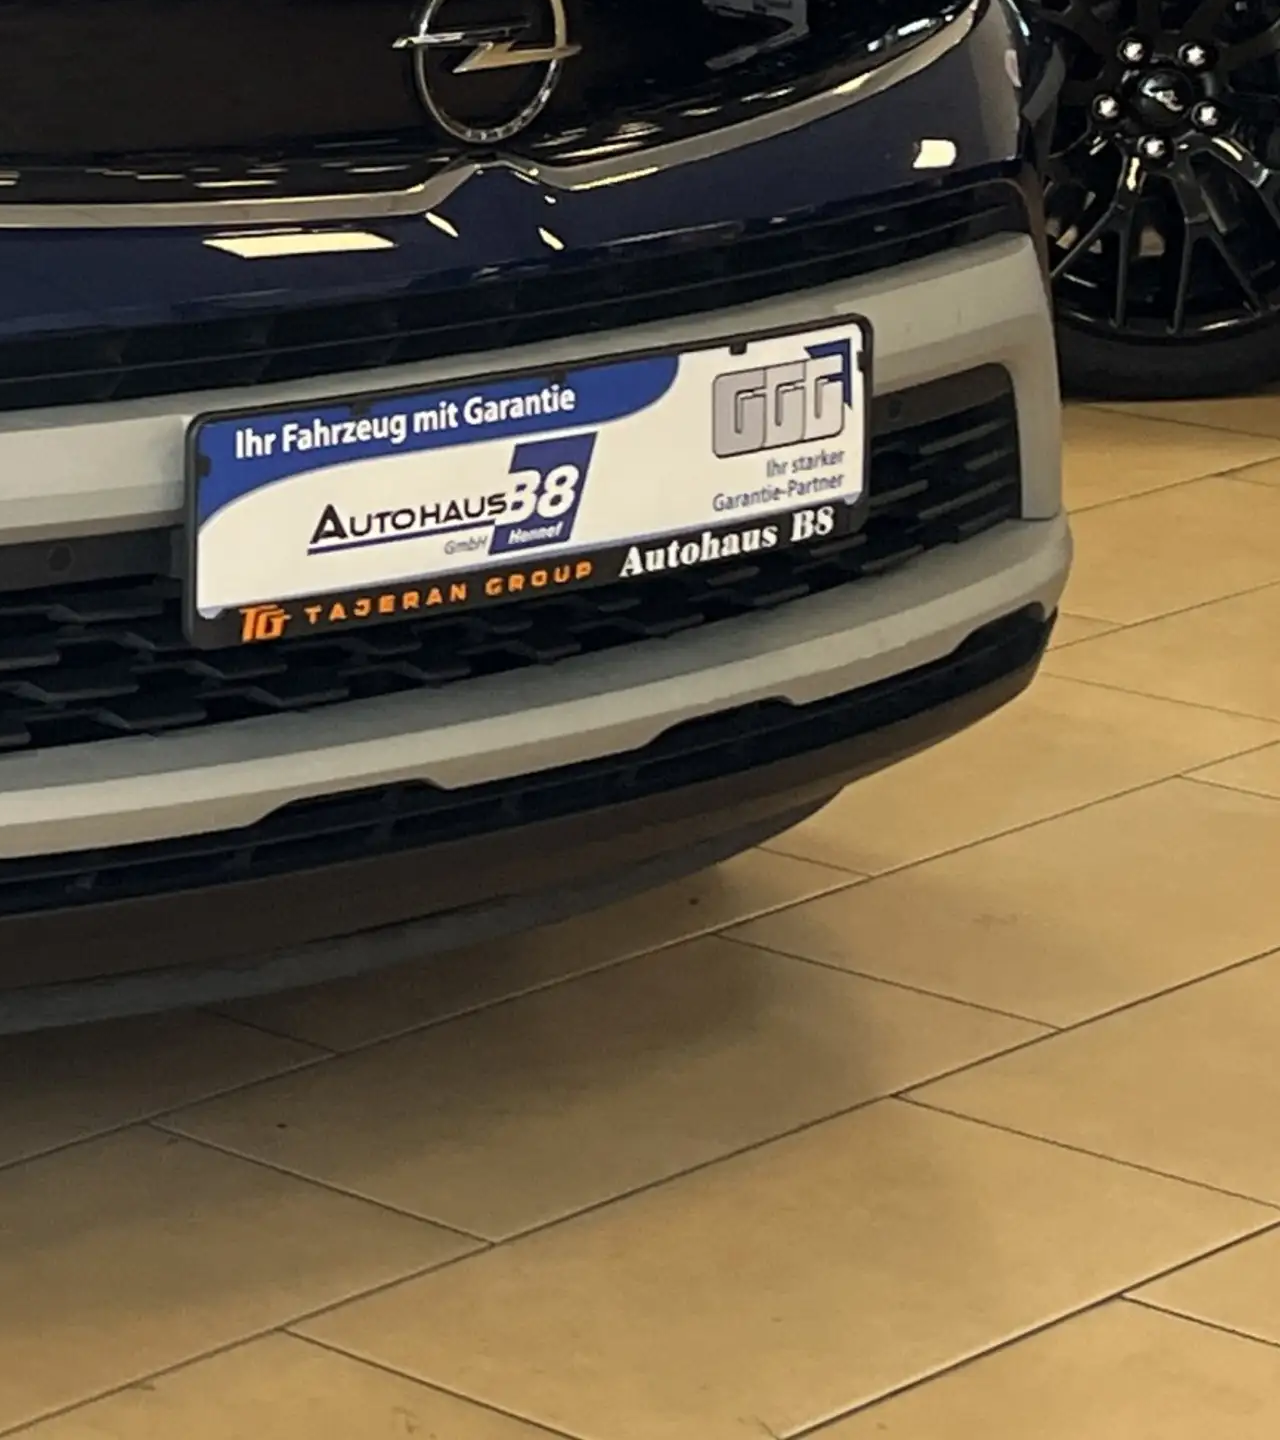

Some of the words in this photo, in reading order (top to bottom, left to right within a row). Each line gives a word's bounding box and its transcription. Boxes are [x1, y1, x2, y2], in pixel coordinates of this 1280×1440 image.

[236, 430, 276, 458] Ihr
[282, 413, 407, 452] Fahrzeug
[413, 402, 458, 432] mit
[464, 384, 576, 423] Garantie
[495, 464, 580, 526] B8
[712, 472, 845, 511] Garantie-Partner
[766, 458, 788, 478] Ihr
[792, 449, 845, 473] starker
[618, 524, 778, 578] Autohaus
[790, 506, 835, 542] B8
[304, 582, 469, 625] TAJERAN
[485, 560, 593, 596] GROUP
